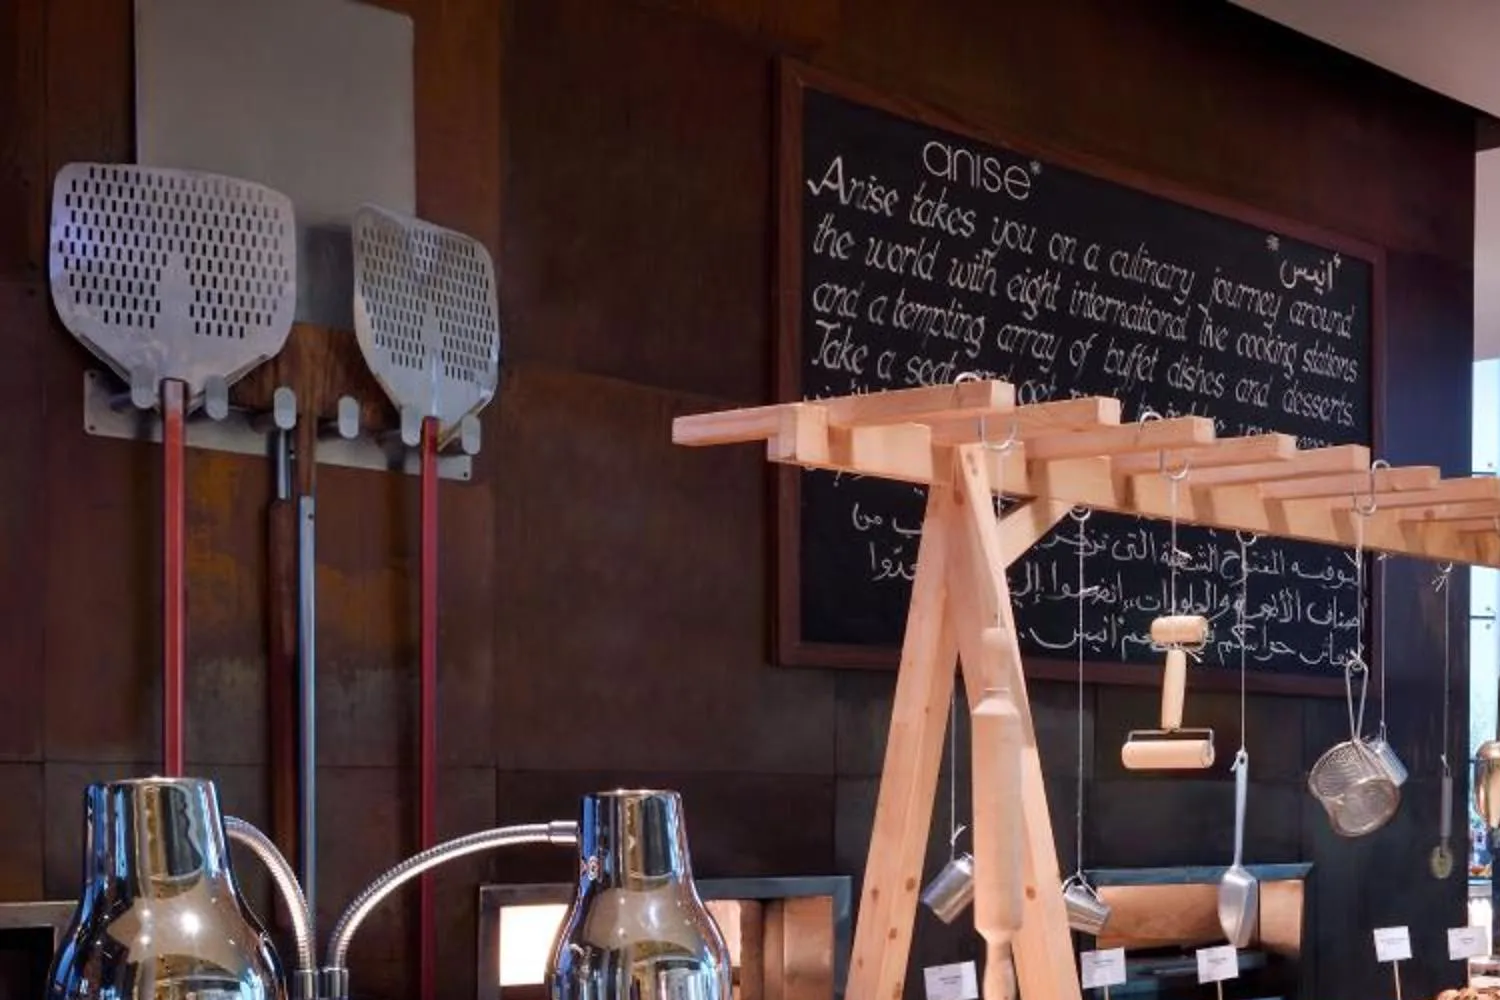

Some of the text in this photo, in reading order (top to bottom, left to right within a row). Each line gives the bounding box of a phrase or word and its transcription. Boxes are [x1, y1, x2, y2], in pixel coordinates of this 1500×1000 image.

[807, 156, 1355, 339] Anise takes you on a culinary journey around
[813, 213, 1358, 382] the world with eight international live cooking stations
[812, 319, 868, 375] Take
[877, 351, 896, 379] a
[905, 351, 958, 385] seat
[813, 281, 865, 319] and
[868, 295, 888, 325] a
[893, 288, 985, 358] tempting
[997, 324, 1061, 373] array
[1069, 333, 1099, 378] of
[1104, 337, 1160, 392] buffet
[1167, 355, 1225, 398] dishes
[1235, 376, 1273, 408] and
